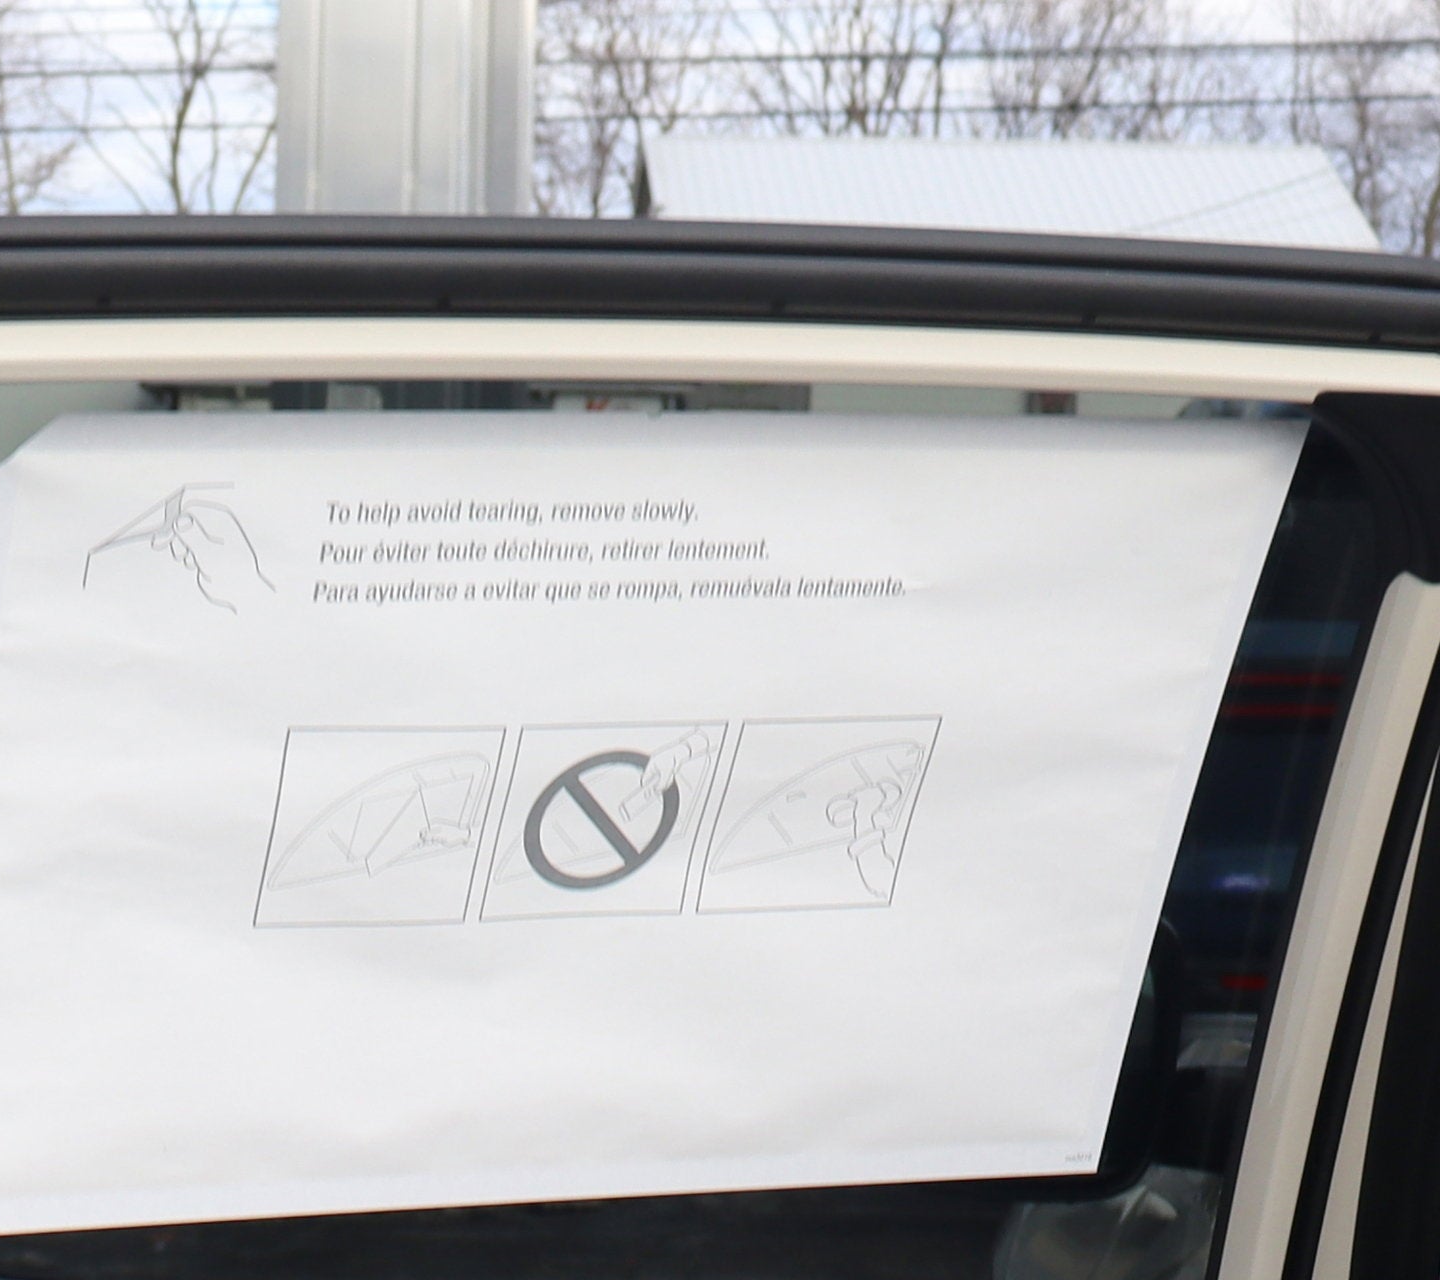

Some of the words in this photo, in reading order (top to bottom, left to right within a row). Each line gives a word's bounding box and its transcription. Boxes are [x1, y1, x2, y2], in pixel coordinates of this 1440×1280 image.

[326, 500, 351, 525] To
[356, 500, 401, 528] help
[406, 498, 463, 523] avoid
[468, 498, 543, 526] tearing,
[551, 502, 626, 522] remove
[631, 498, 699, 526] slowly.
[319, 541, 368, 565] Pour
[372, 540, 431, 564] éviter
[436, 539, 488, 562] toute
[493, 538, 594, 564] déchirure,
[601, 538, 660, 561] retirer
[667, 537, 770, 561] lentement.
[312, 580, 359, 604] Para
[365, 578, 458, 607] ayudarse
[463, 583, 476, 601] a
[482, 578, 541, 602] evitar
[544, 582, 582, 605] que
[587, 581, 611, 600] se
[616, 581, 683, 604] rompa,
[689, 575, 792, 599] remuévala
[796, 575, 907, 599] lentamente.
